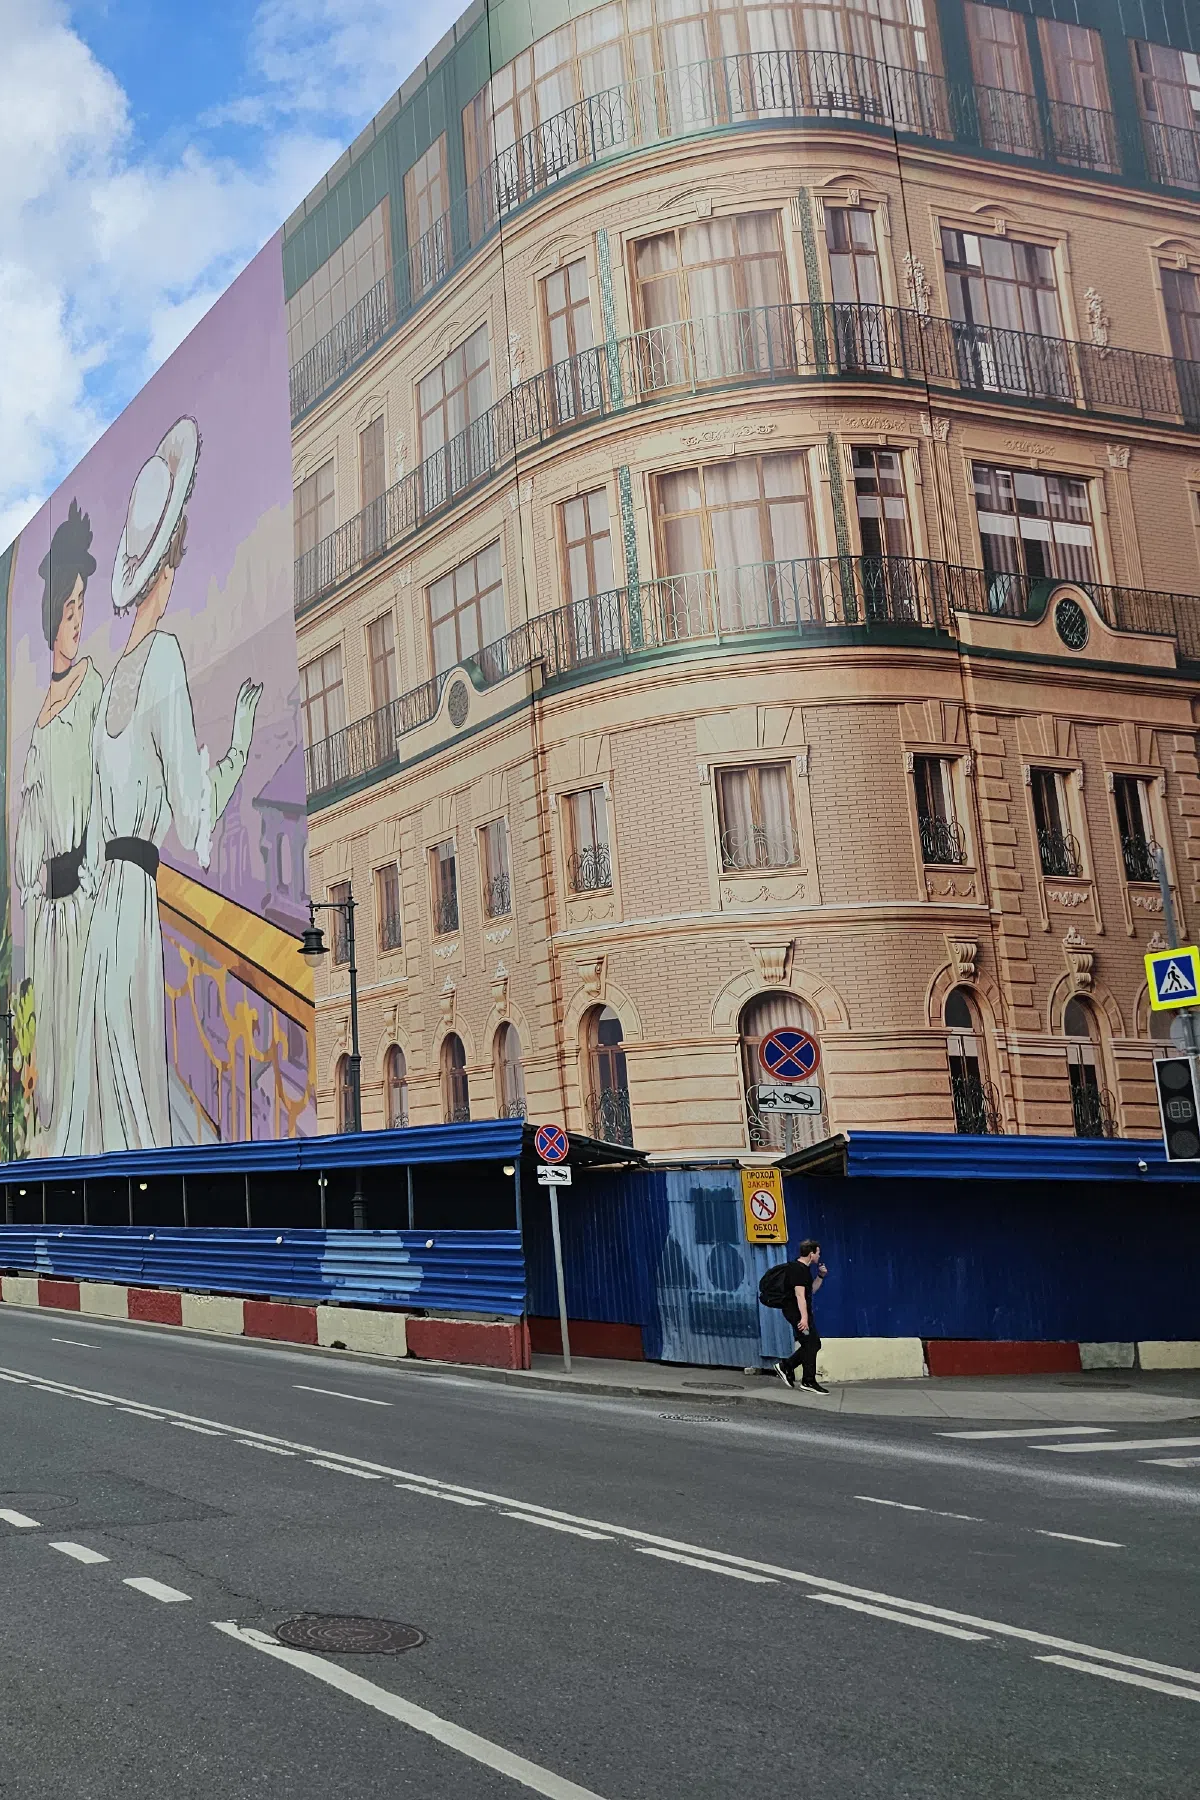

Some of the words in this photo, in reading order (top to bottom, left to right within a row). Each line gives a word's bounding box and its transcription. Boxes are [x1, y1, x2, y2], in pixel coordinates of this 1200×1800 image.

[746, 1171, 775, 1180] ПРОХОД
[747, 1180, 775, 1188] ЗАКРЫТ
[753, 1223, 779, 1232] ОБХОД
